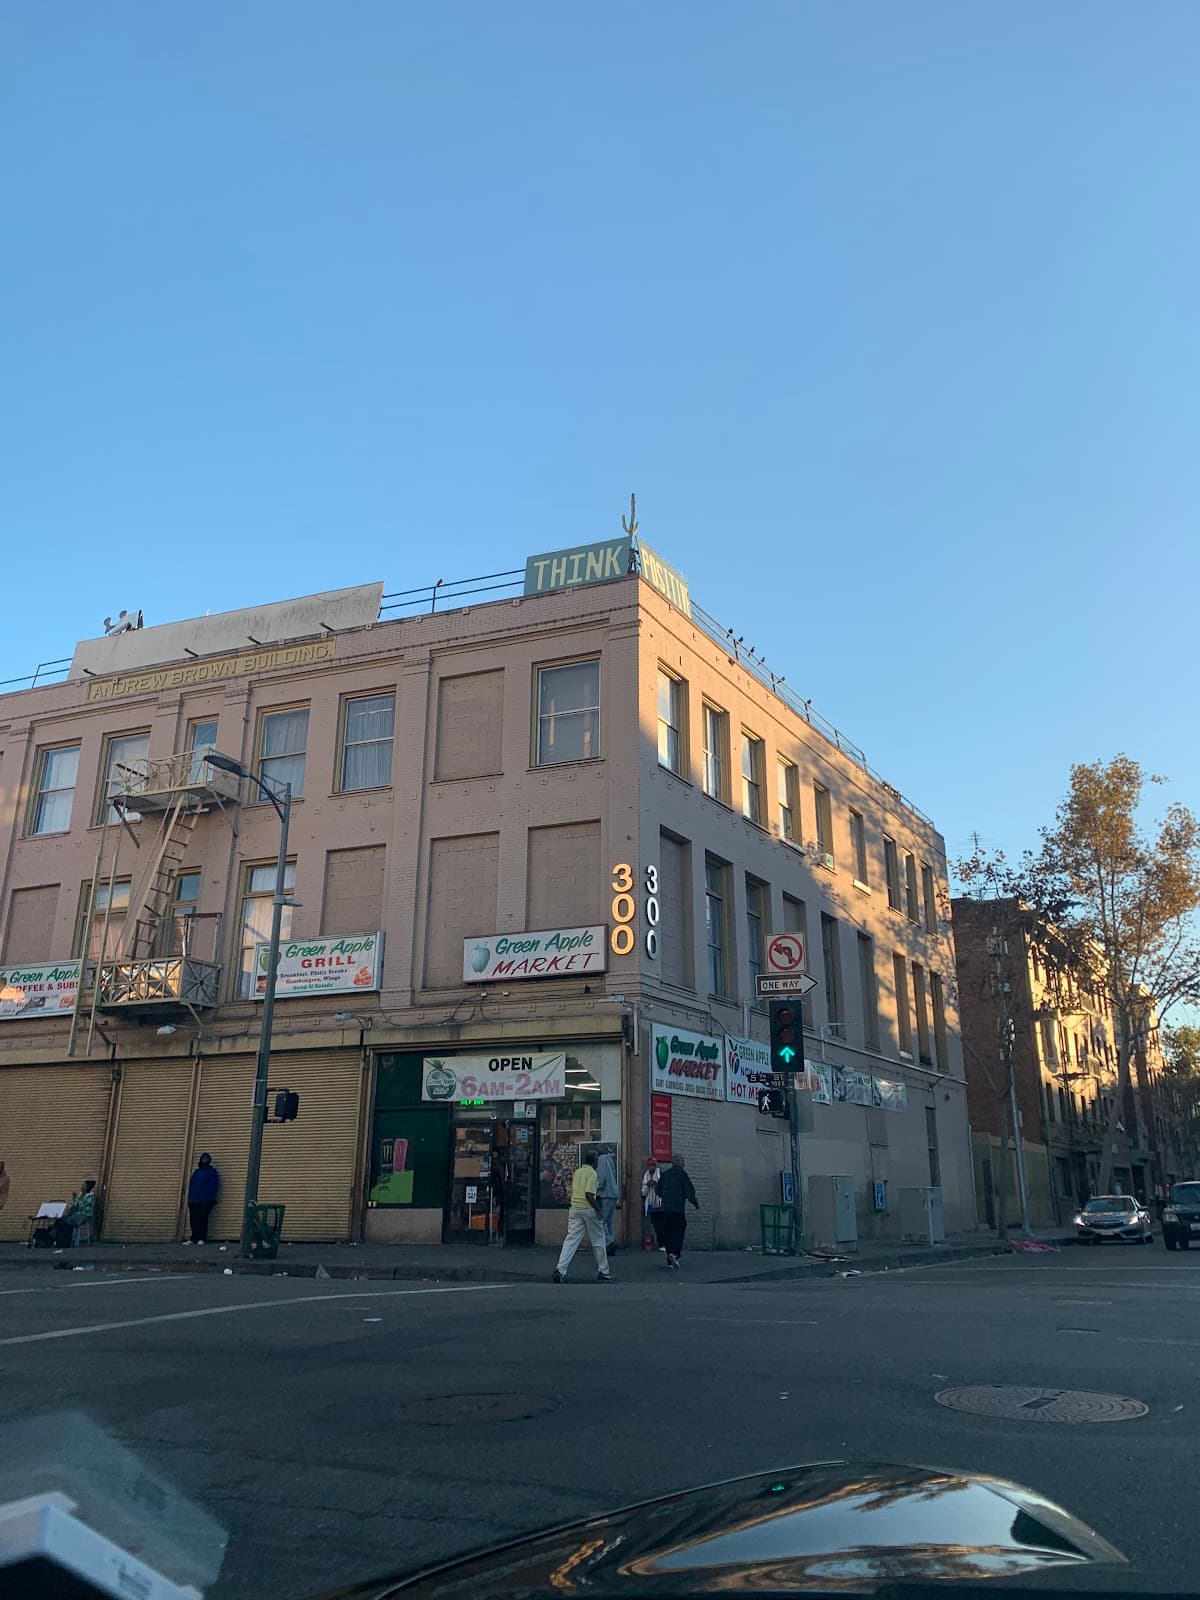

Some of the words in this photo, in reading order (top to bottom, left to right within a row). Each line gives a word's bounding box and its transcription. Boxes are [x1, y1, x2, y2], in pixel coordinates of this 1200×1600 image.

[534, 545, 623, 591] THINK
[92, 673, 168, 699] ANDREW
[170, 660, 238, 685] BROWN
[612, 863, 635, 955] 300
[646, 865, 660, 960] 300
[285, 944, 327, 958] Green
[330, 937, 375, 955] Apple
[495, 938, 541, 955] Green
[544, 930, 594, 952] Apple
[301, 955, 356, 969] GRILL
[491, 952, 600, 977] MARKET
[10, 970, 43, 984] Green
[15, 983, 44, 993] OFFEE
[47, 983, 54, 991] &
[762, 981, 780, 990] ONE
[781, 980, 800, 989] WAY
[488, 1057, 533, 1072] OPEN
[668, 1057, 722, 1081] MARKET
[730, 1082, 746, 1099] HOT
